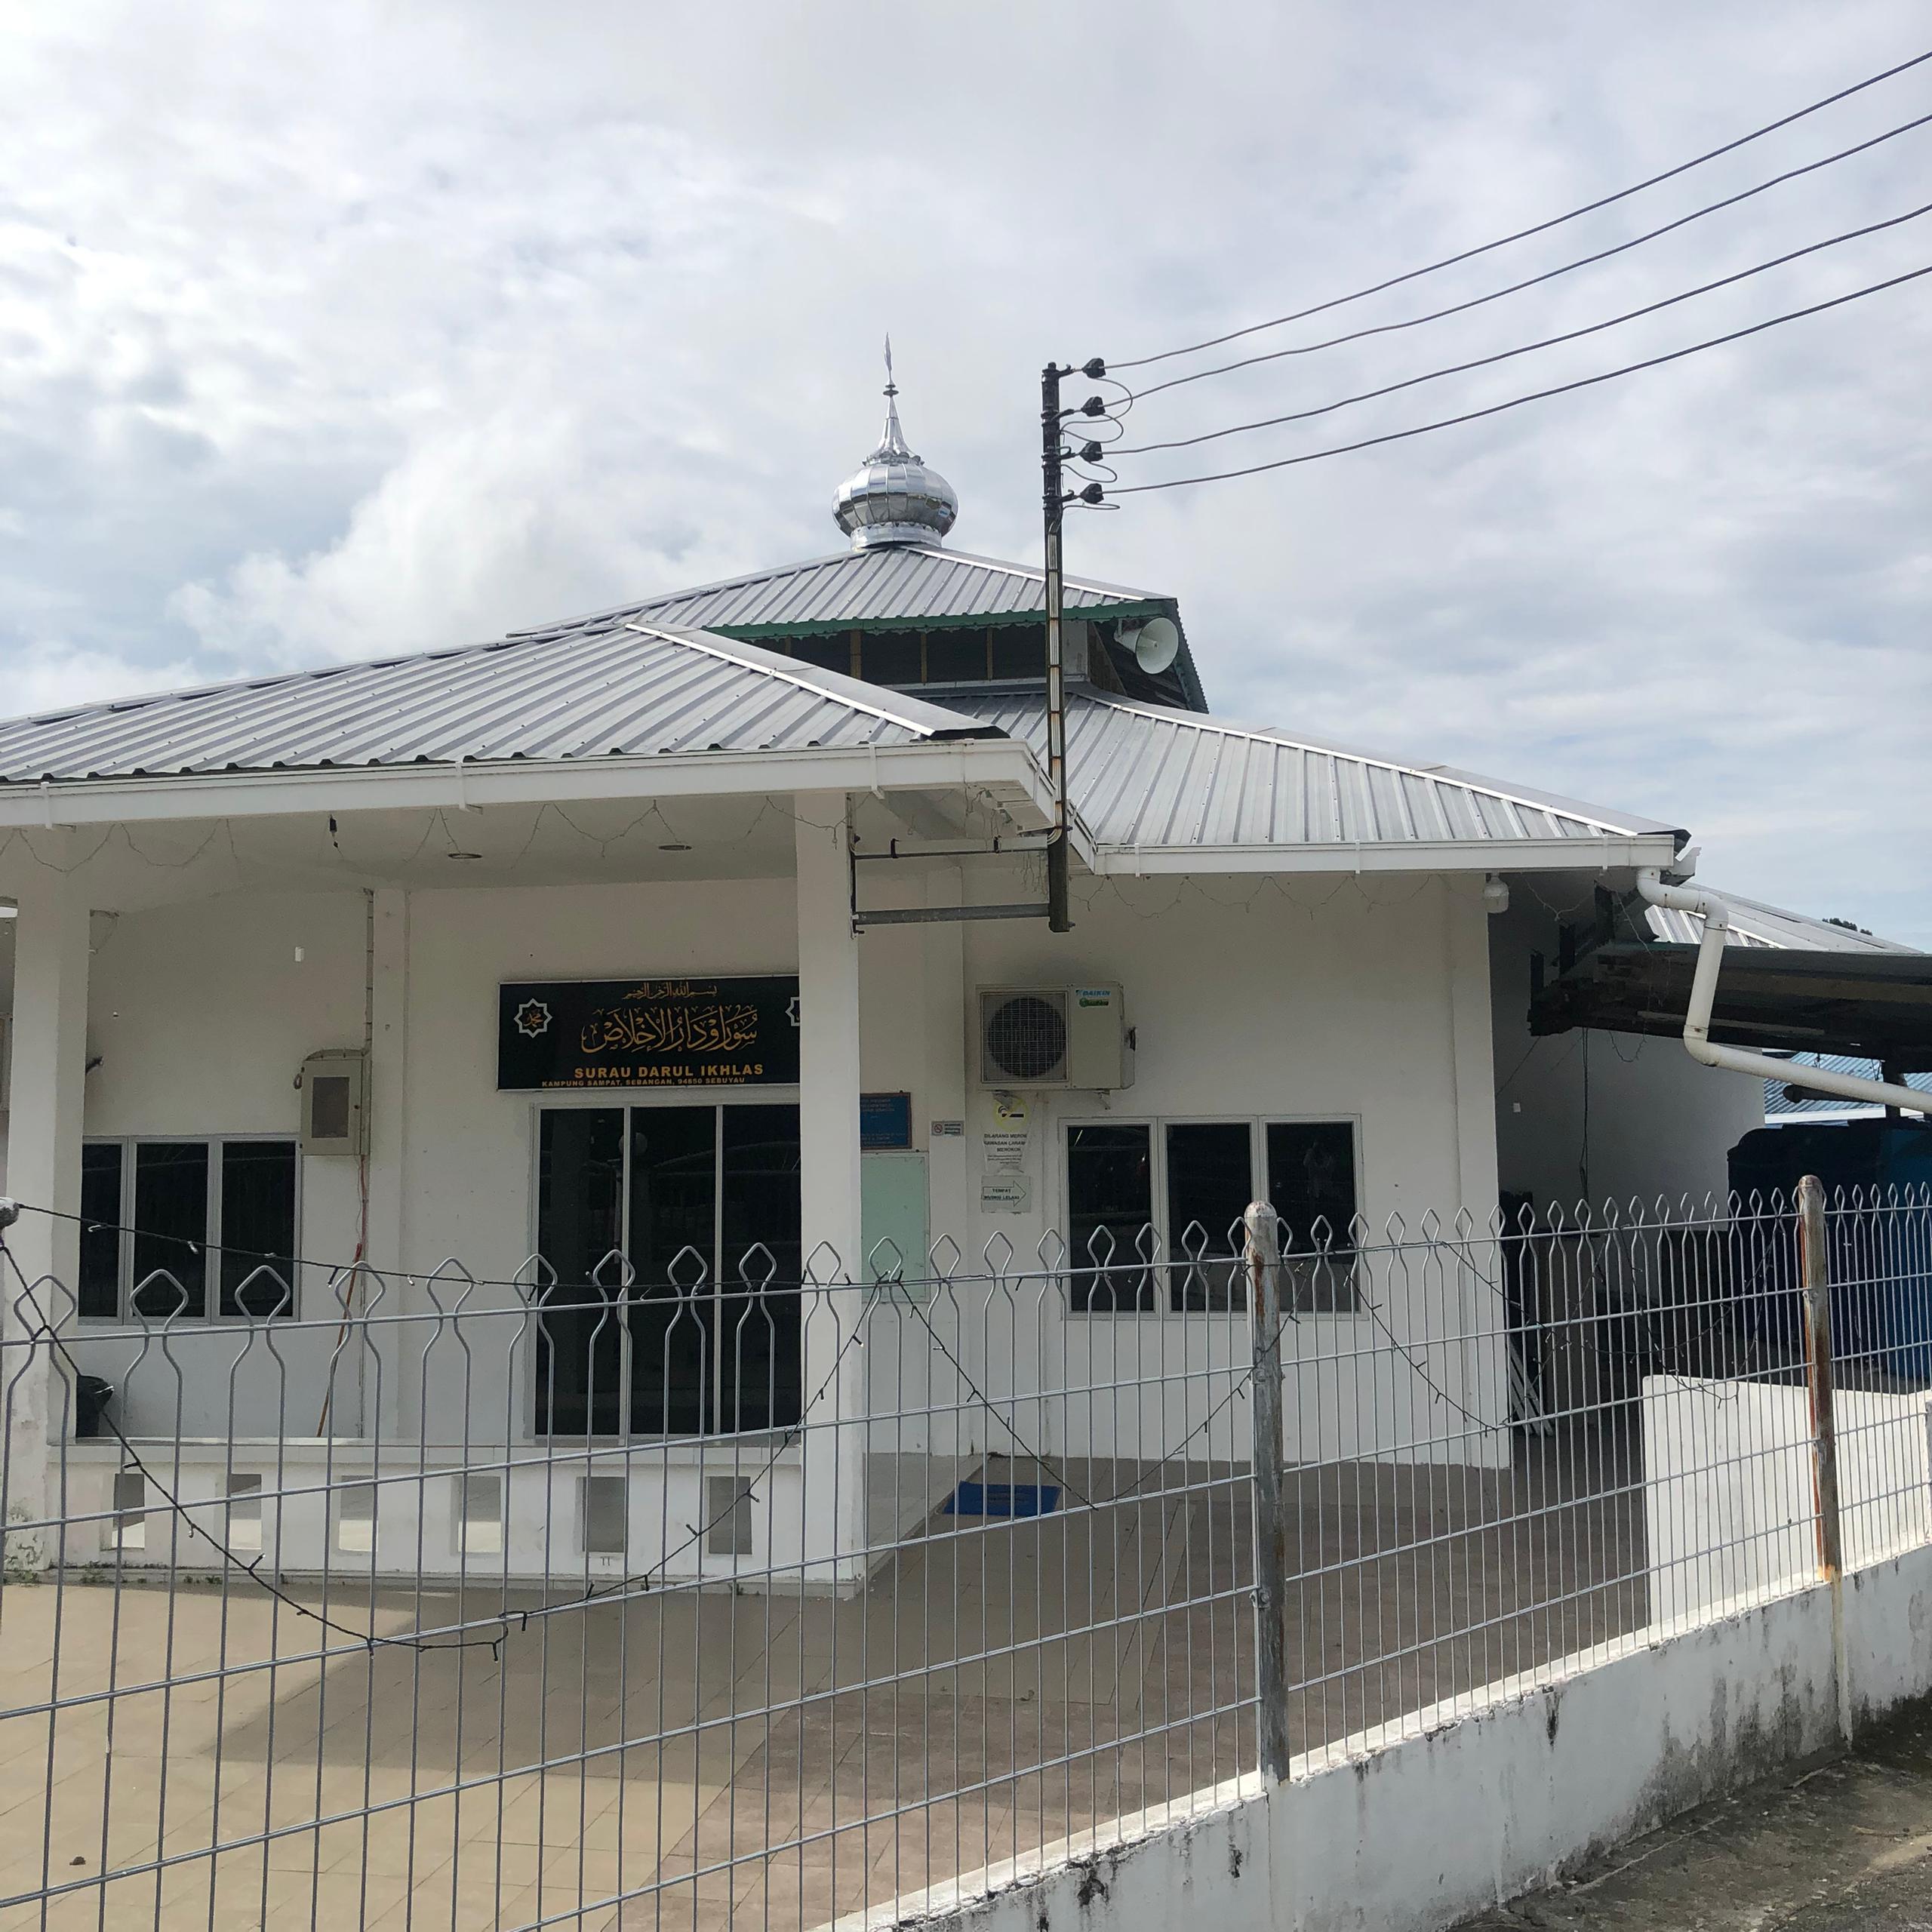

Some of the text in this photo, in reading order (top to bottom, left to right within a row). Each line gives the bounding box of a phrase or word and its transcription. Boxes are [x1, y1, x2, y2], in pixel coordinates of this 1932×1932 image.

[574, 1064, 764, 1078] SURAU DARUL IKHLAS
